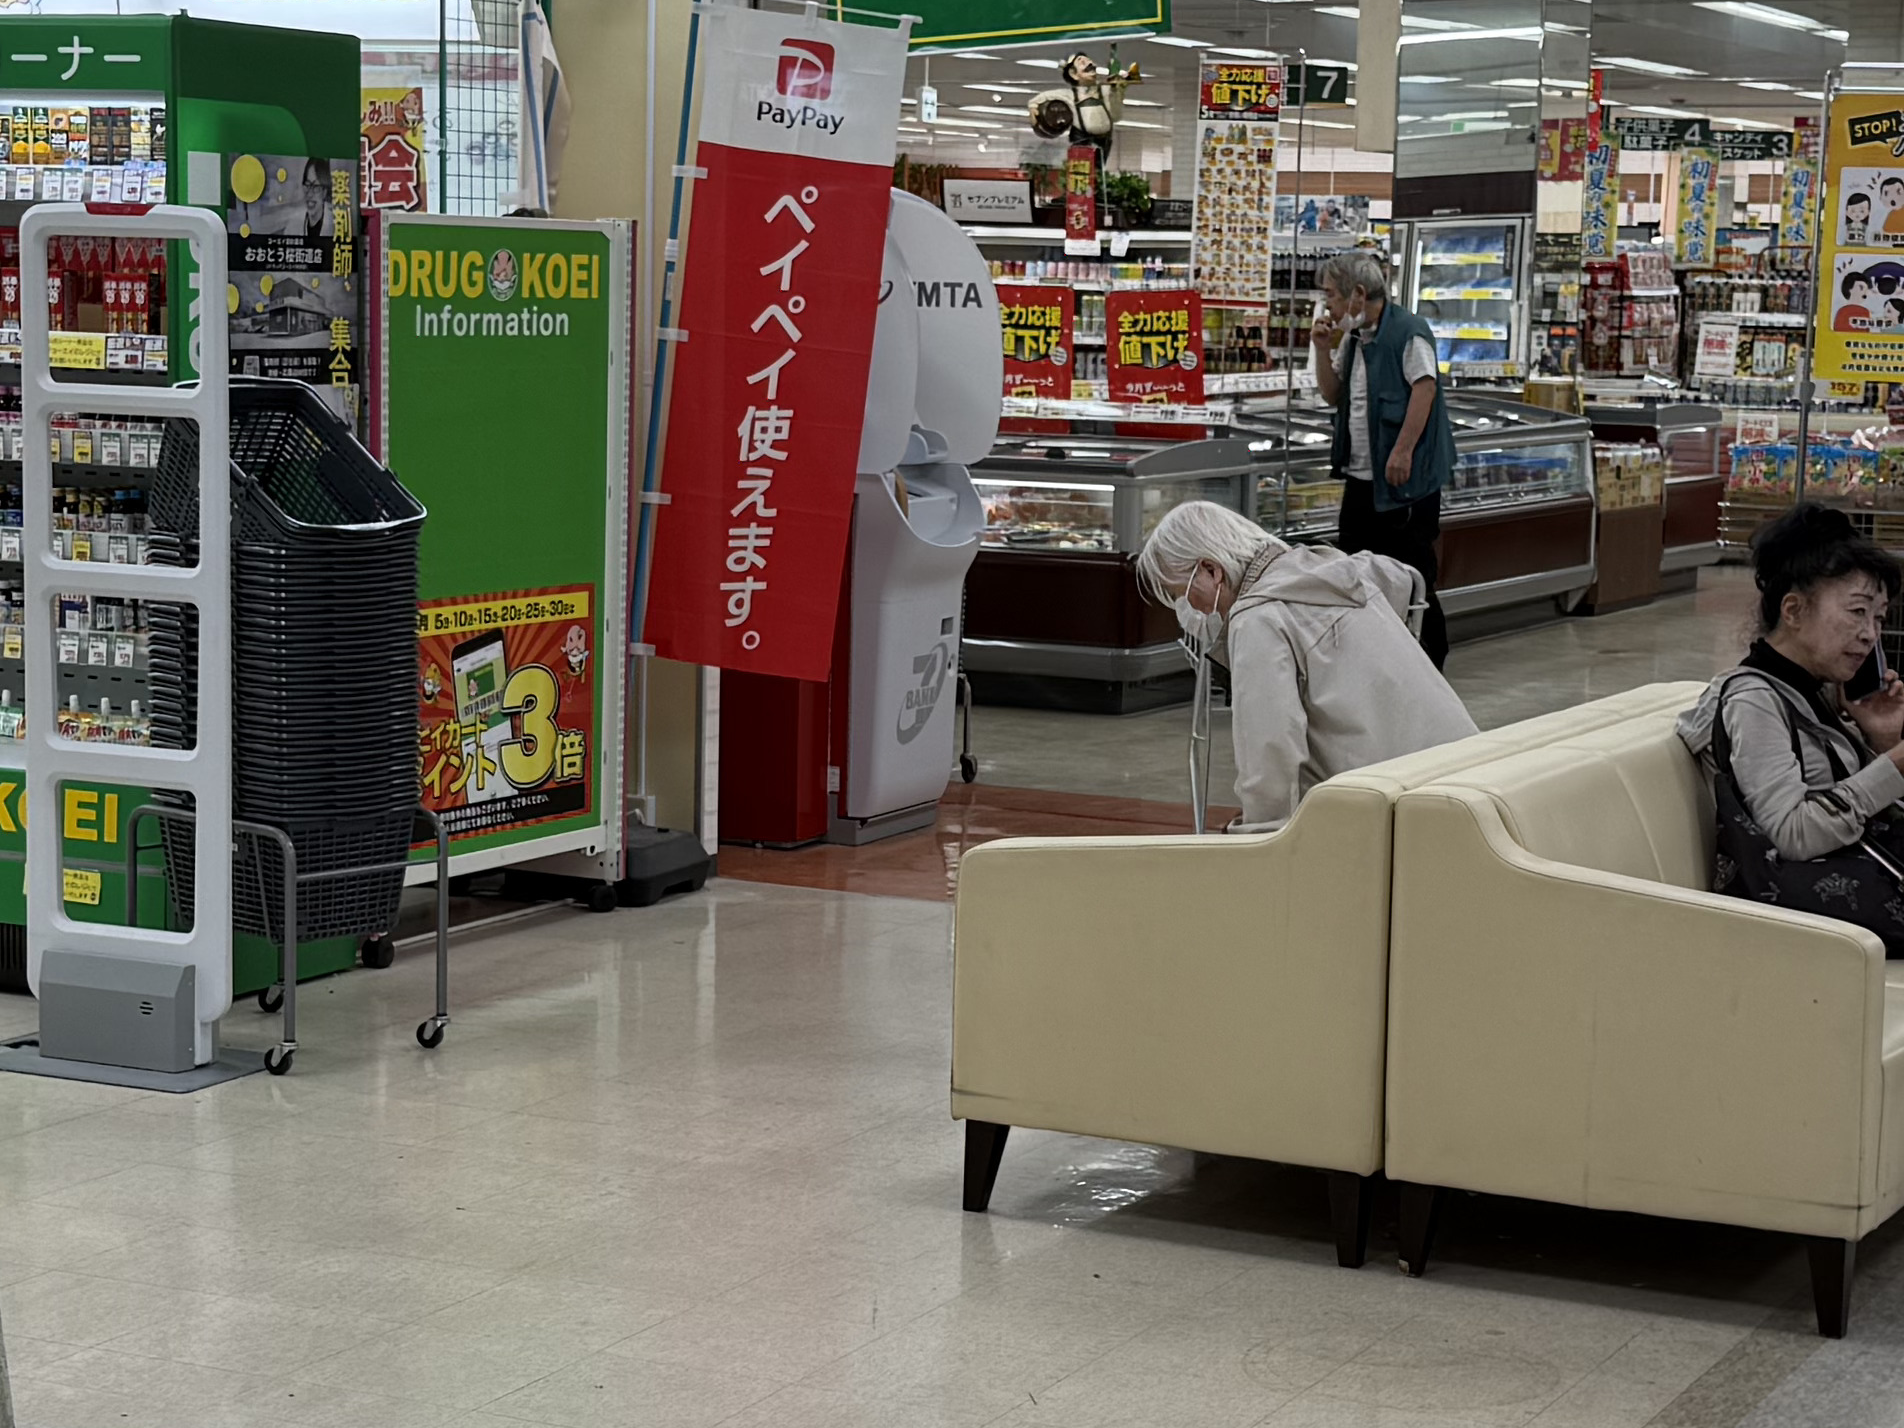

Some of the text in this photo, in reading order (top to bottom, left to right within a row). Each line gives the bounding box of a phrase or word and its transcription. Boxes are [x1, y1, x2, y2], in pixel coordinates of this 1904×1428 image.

[1218, 66, 1266, 83] 全力応援
[1316, 70, 1339, 100] 7
[1210, 83, 1271, 106] 値下げ
[756, 100, 845, 135] PayPay
[1618, 119, 1676, 135] 子供菓子
[1853, 117, 1897, 140] STOP!
[1683, 122, 1702, 142] 4
[1712, 131, 1765, 145] キャンディ
[1720, 146, 1763, 160] スケット
[1770, 134, 1791, 158] 3
[967, 194, 1025, 205] セブンプレミアム
[244, 246, 324, 265] おおとう桜街道店
[388, 249, 600, 300] DRUG KOEI
[912, 280, 983, 309] MTA
[415, 304, 570, 340] Information
[998, 304, 1062, 328] 全力応援
[1117, 309, 1190, 334] 全力応援
[1118, 332, 1190, 369] 値下げ
[719, 184, 820, 654] ペイペイ使えます。
[418, 746, 498, 800] イント
